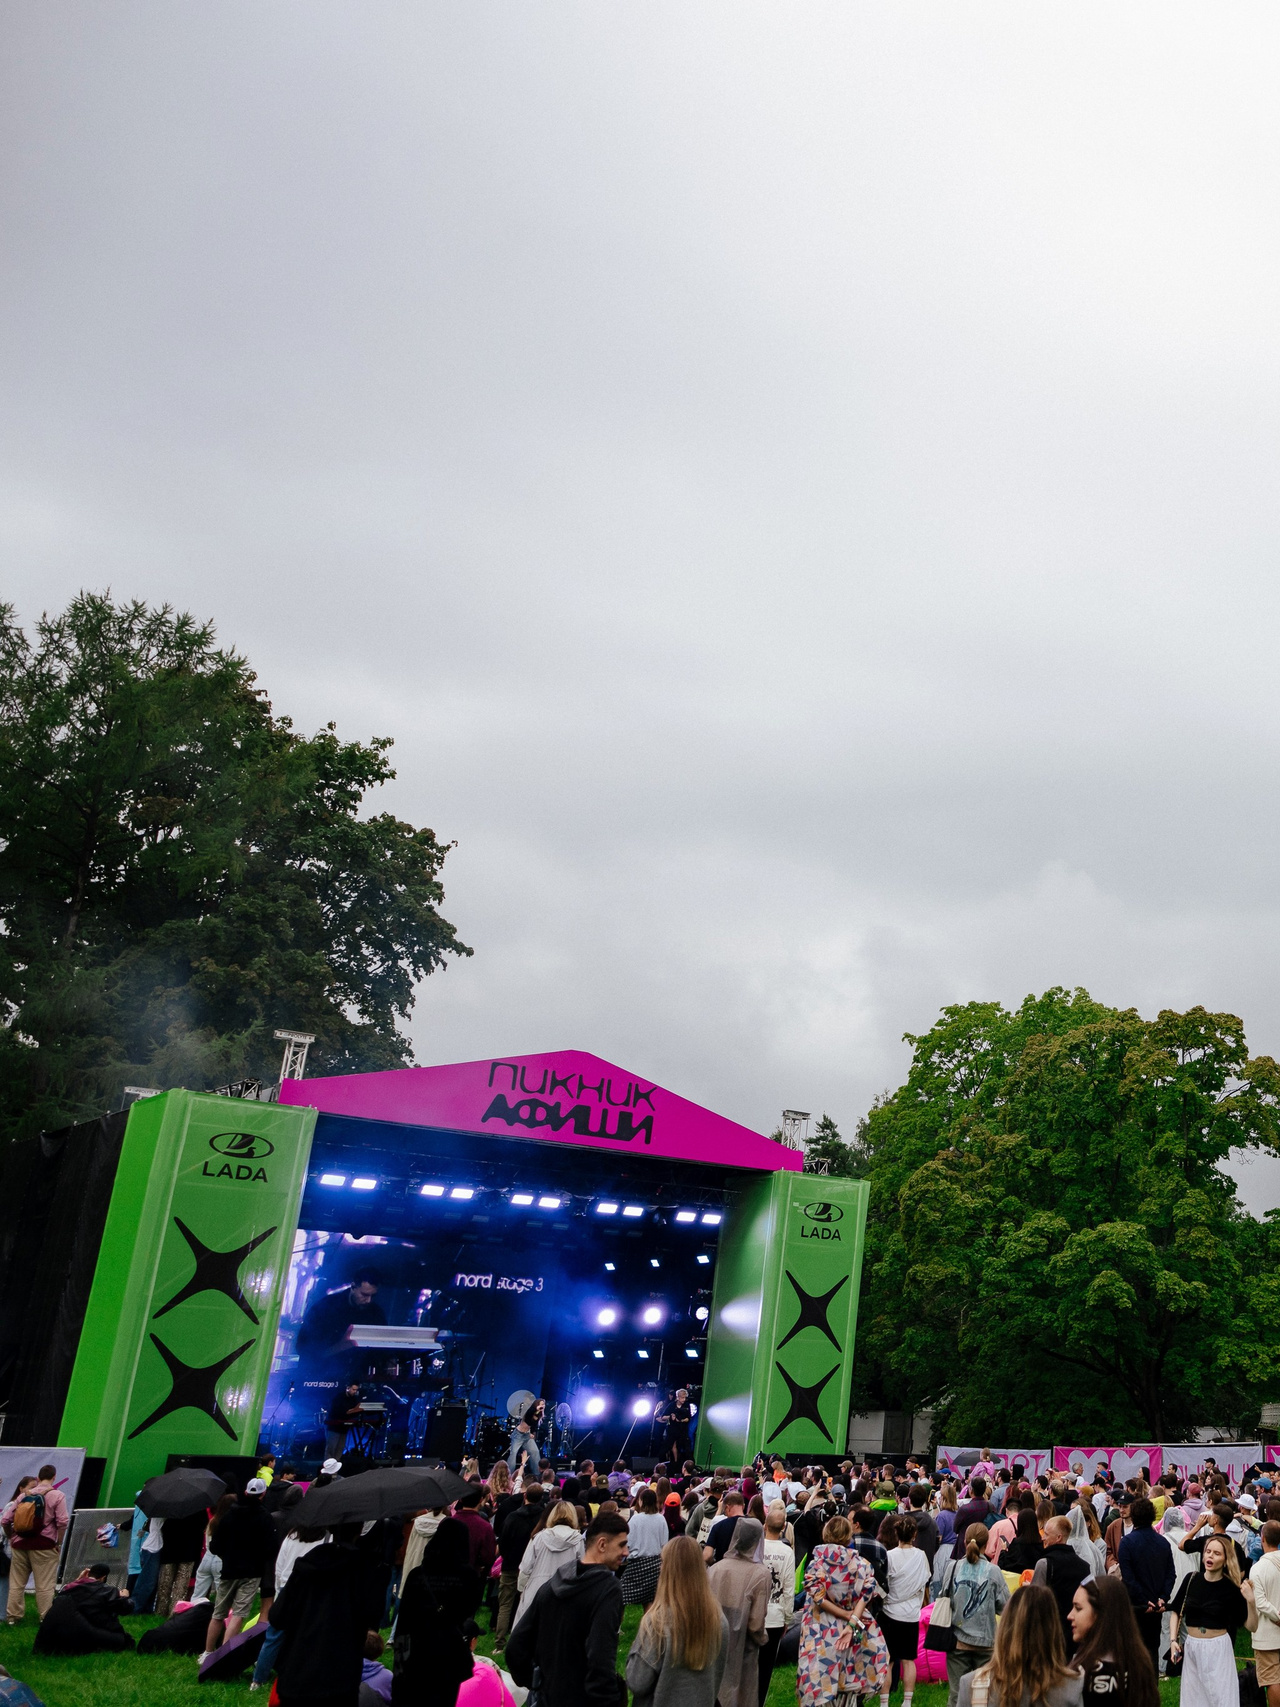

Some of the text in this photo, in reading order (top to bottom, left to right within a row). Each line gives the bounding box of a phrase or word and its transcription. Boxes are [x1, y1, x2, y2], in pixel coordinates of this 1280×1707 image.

[488, 1062, 657, 1112] ПИКНИК
[481, 1093, 653, 1145] АФИШИ
[202, 1161, 268, 1183] LADA
[801, 1226, 841, 1241] LADA
[455, 1274, 493, 1288] nord
[535, 1277, 544, 1292] 3
